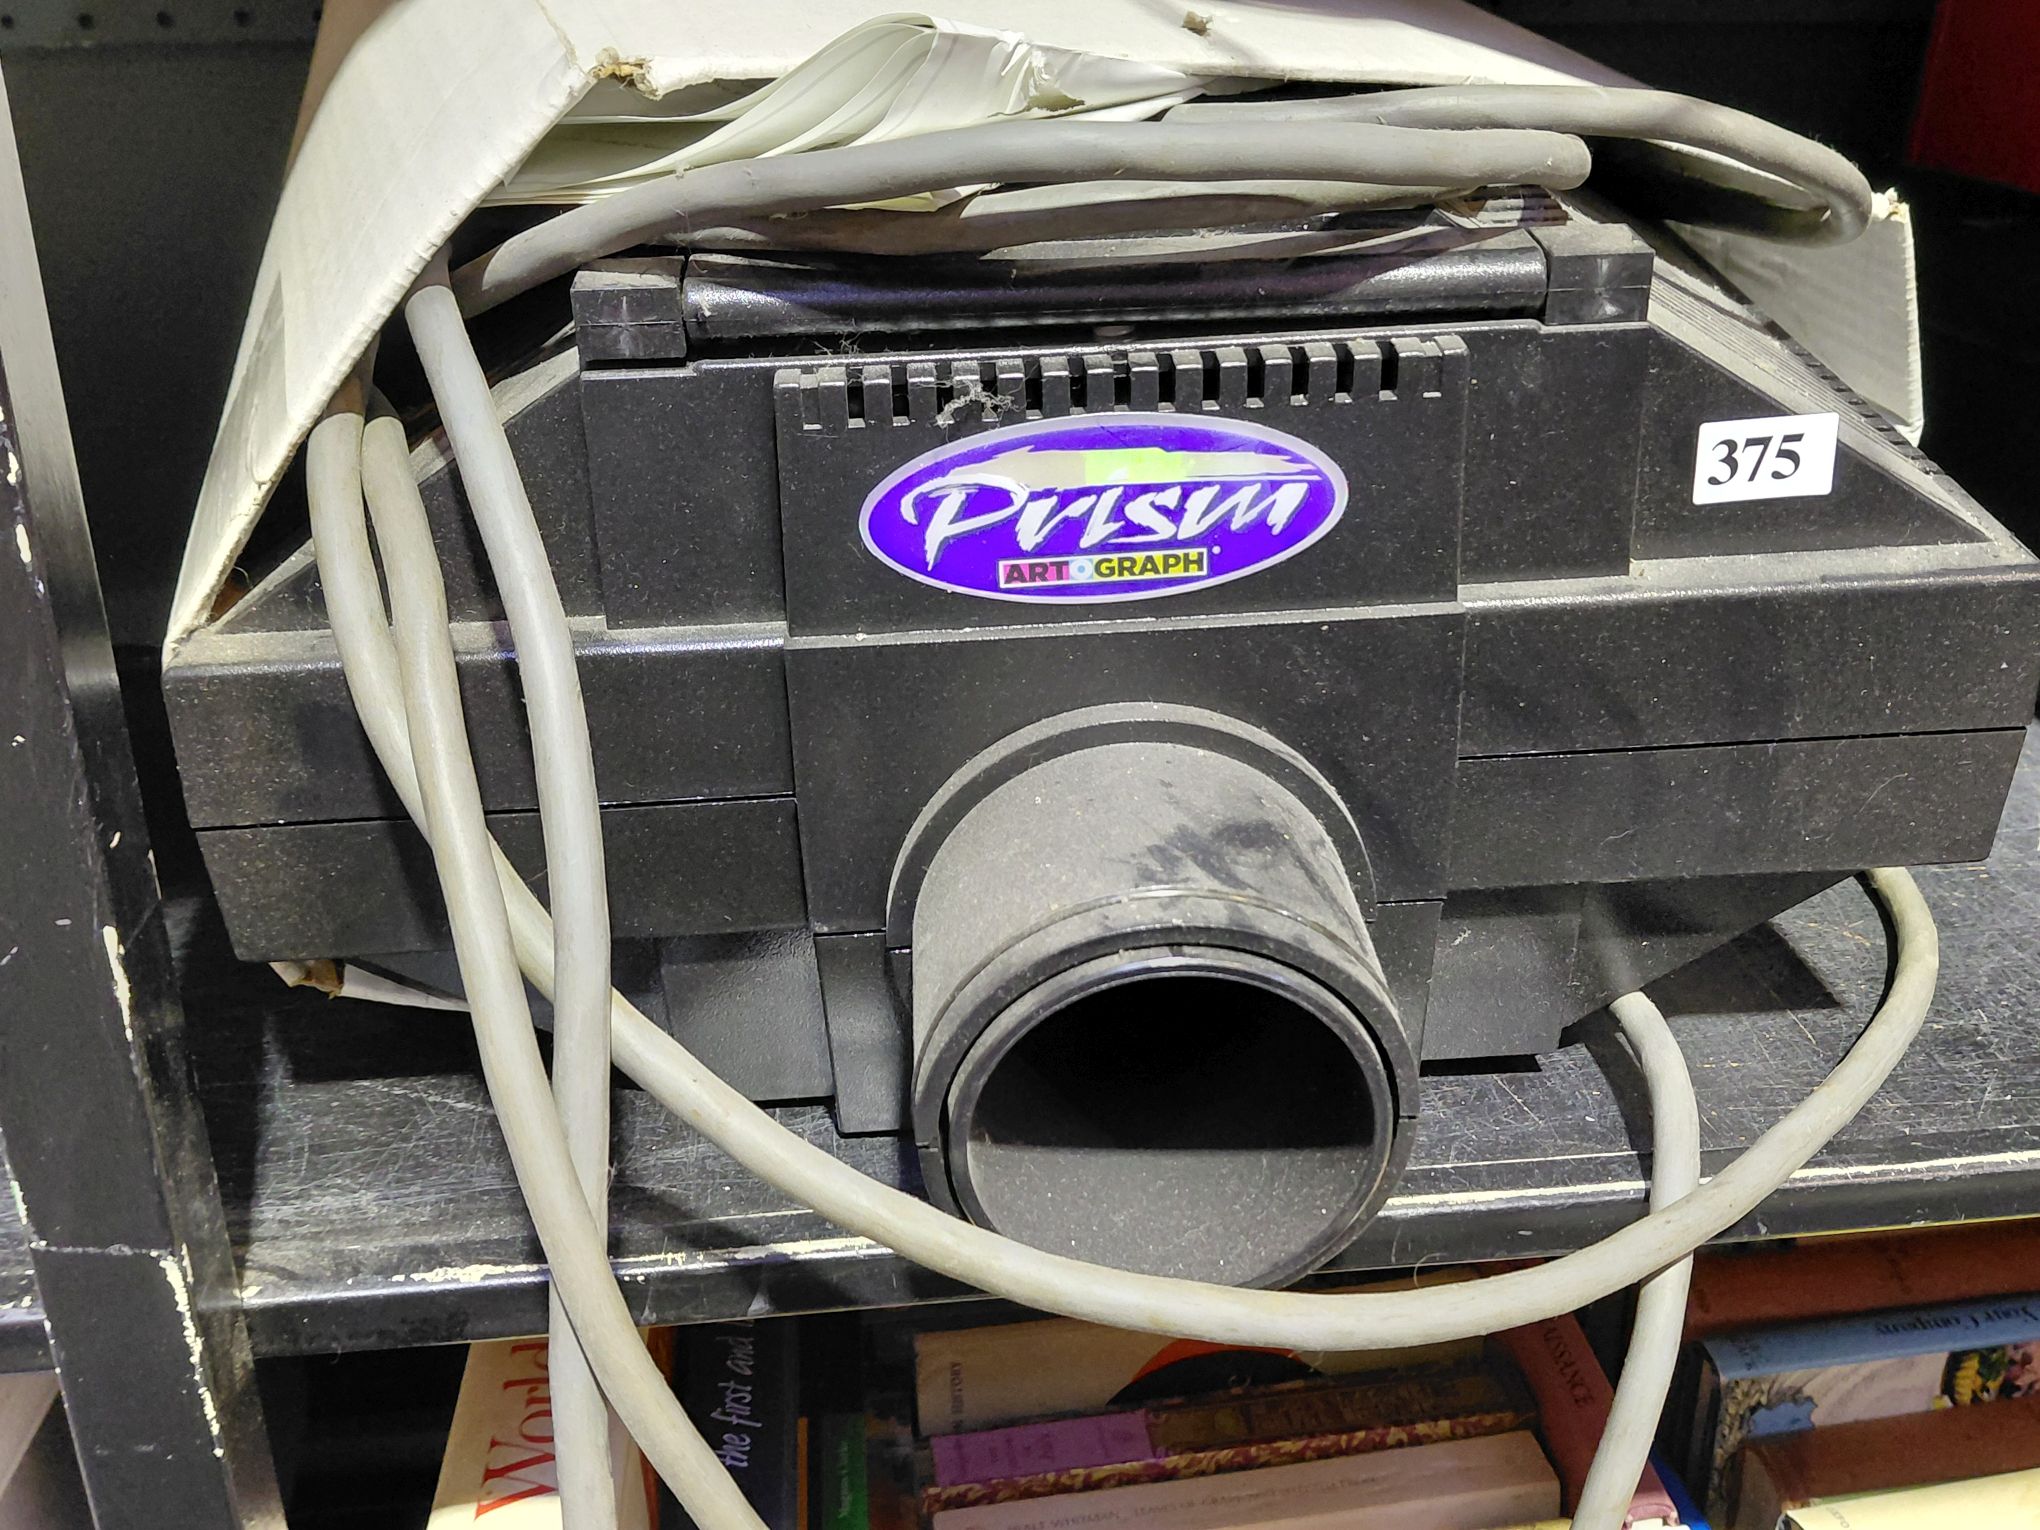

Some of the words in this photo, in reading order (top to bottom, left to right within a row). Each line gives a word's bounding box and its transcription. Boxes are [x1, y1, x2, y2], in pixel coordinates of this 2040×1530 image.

[1707, 433, 1805, 486] 375
[901, 472, 1310, 572] Prism
[1004, 552, 1204, 585] ARTOGRAPH
[716, 1335, 754, 1375] and
[710, 1380, 762, 1427] first
[715, 1433, 751, 1467] the
